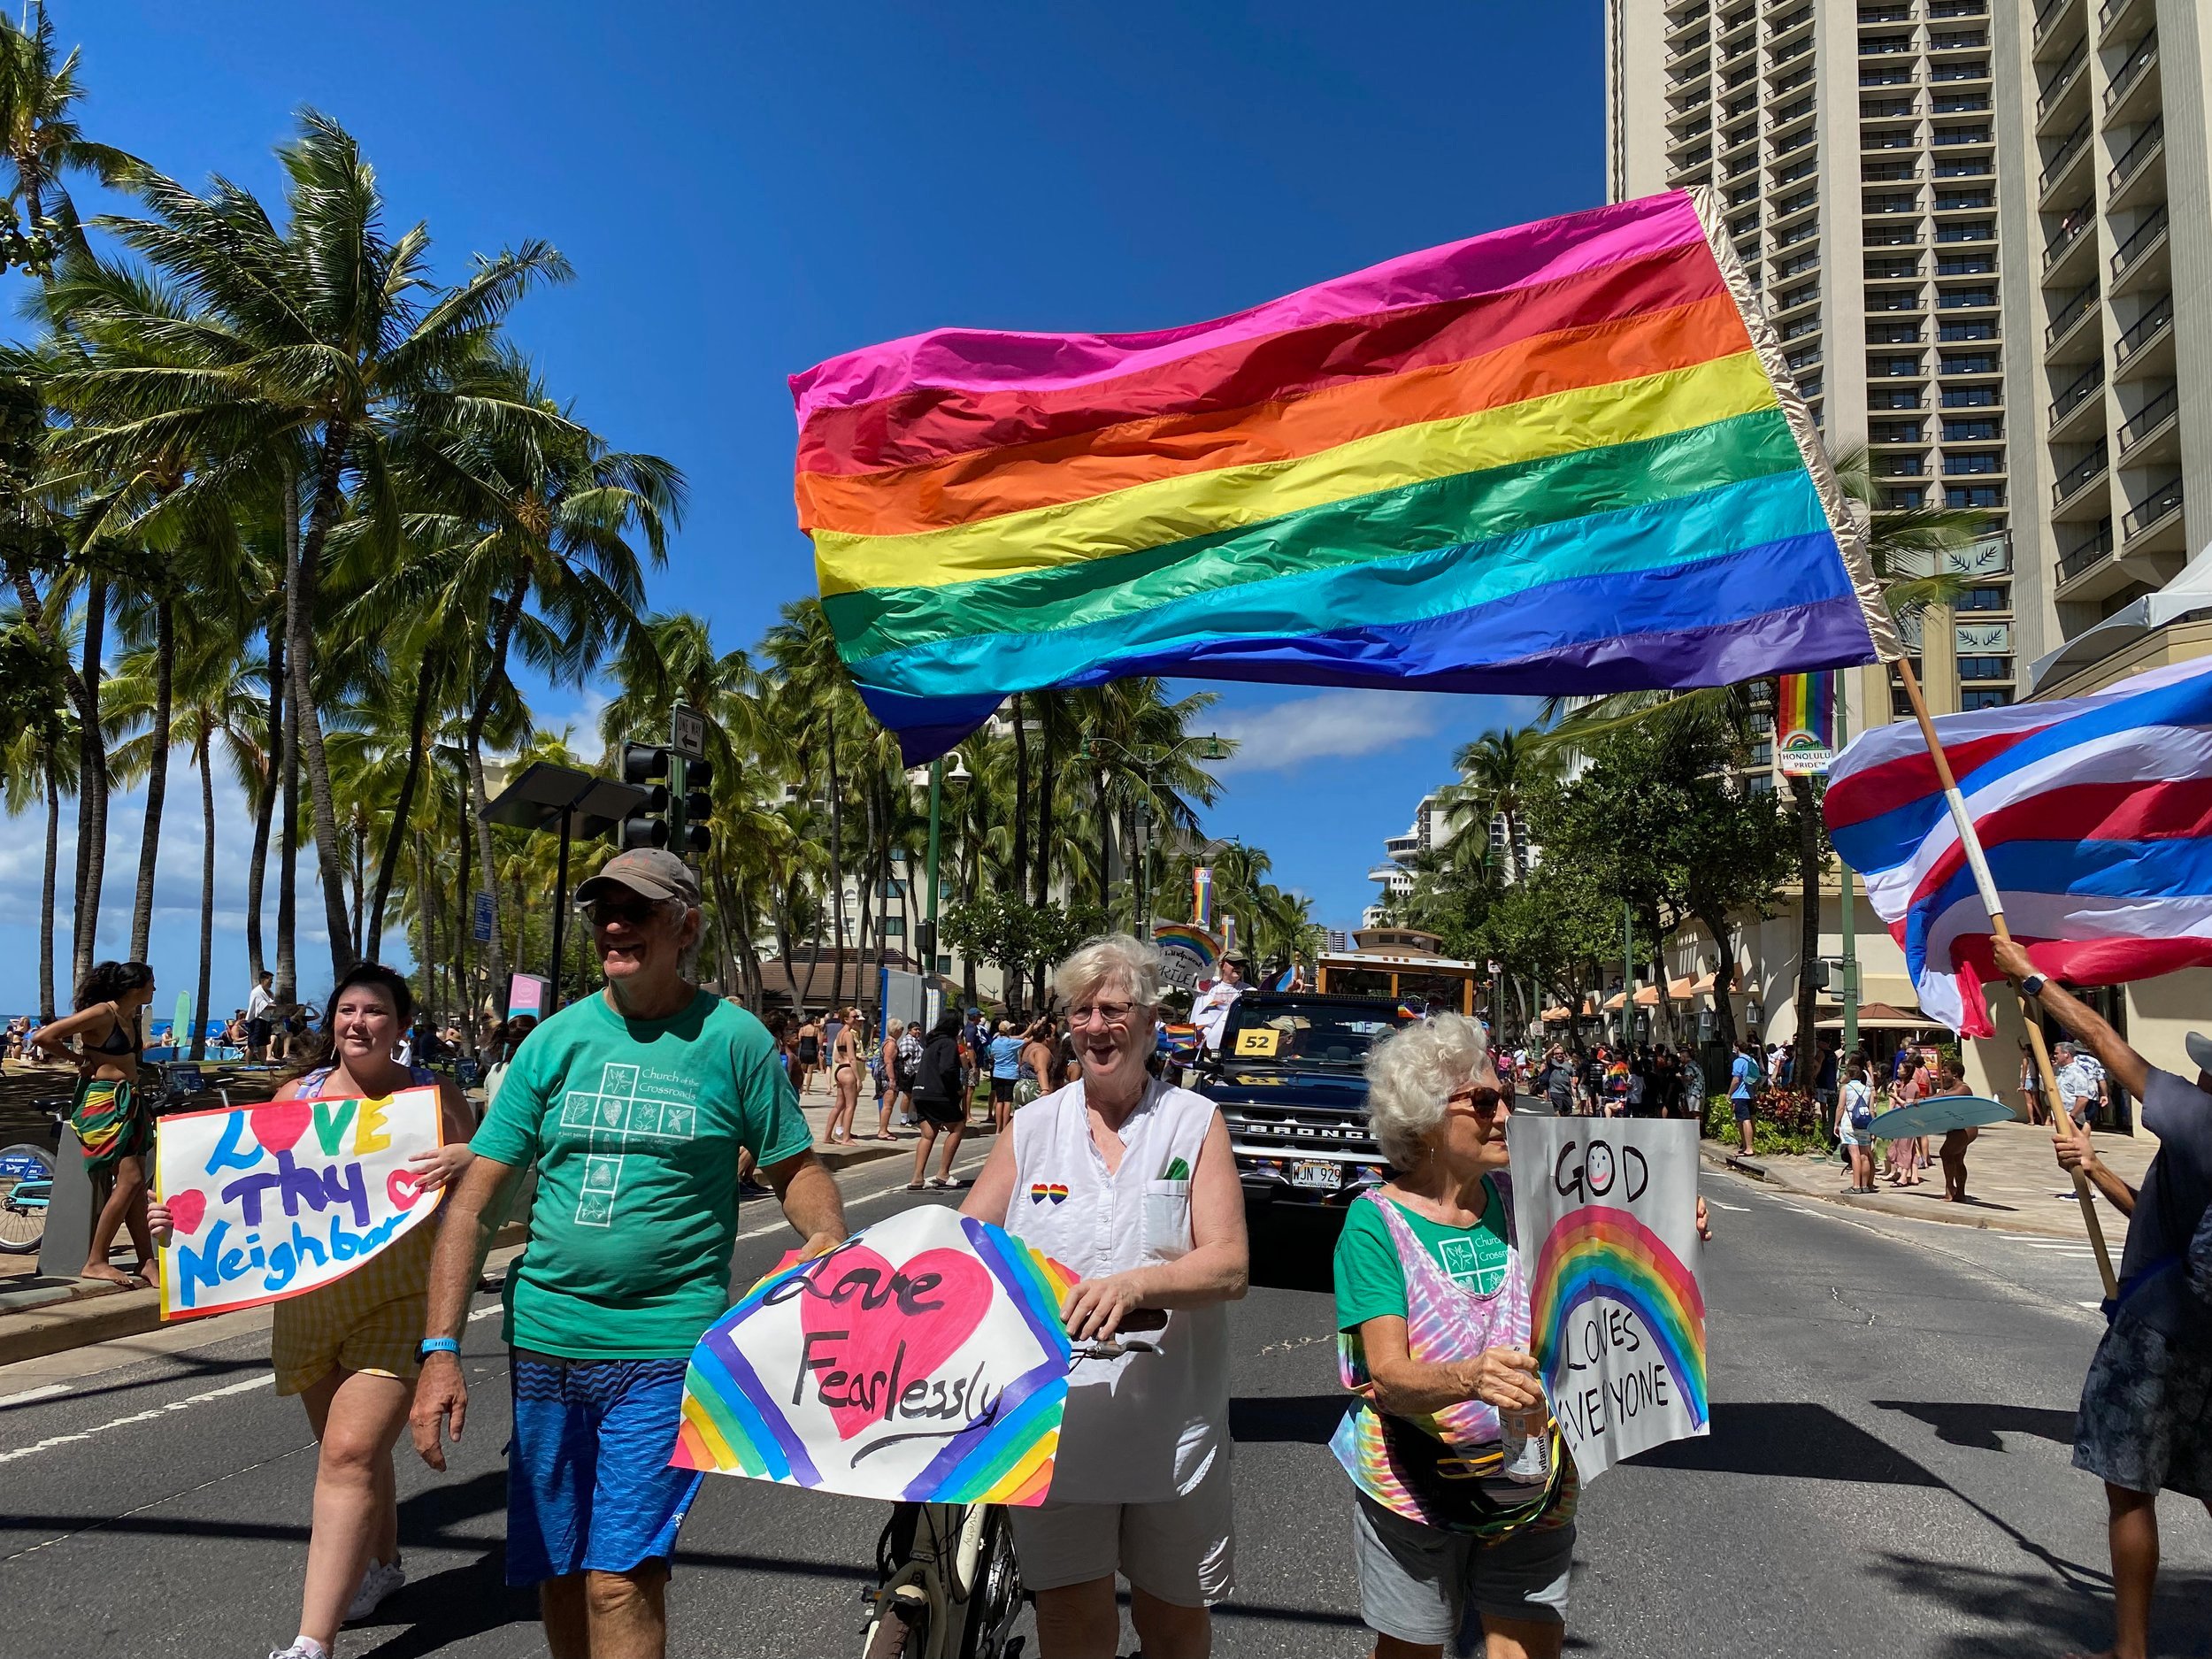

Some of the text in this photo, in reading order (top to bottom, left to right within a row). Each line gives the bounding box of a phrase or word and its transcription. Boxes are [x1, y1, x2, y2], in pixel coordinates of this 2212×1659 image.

[678, 716, 701, 736] ONE WAY
[1244, 1035, 1270, 1048] 52
[639, 1082, 697, 1101] Crossroads
[641, 1066, 680, 1082] Church
[688, 1078, 700, 1087] the
[205, 1094, 395, 1176] LOVE
[221, 1150, 370, 1226] Thy
[1293, 1166, 1341, 1182] WJN 929
[1555, 1140, 1648, 1203] GOD
[178, 1211, 411, 1307] Neighbor
[1475, 1234, 1502, 1247] Churc
[763, 1238, 945, 1317] Love
[1564, 1308, 1640, 1371] LOVES
[792, 1330, 1005, 1428] Fearlessly
[1536, 1435, 1548, 1471] vitamin
